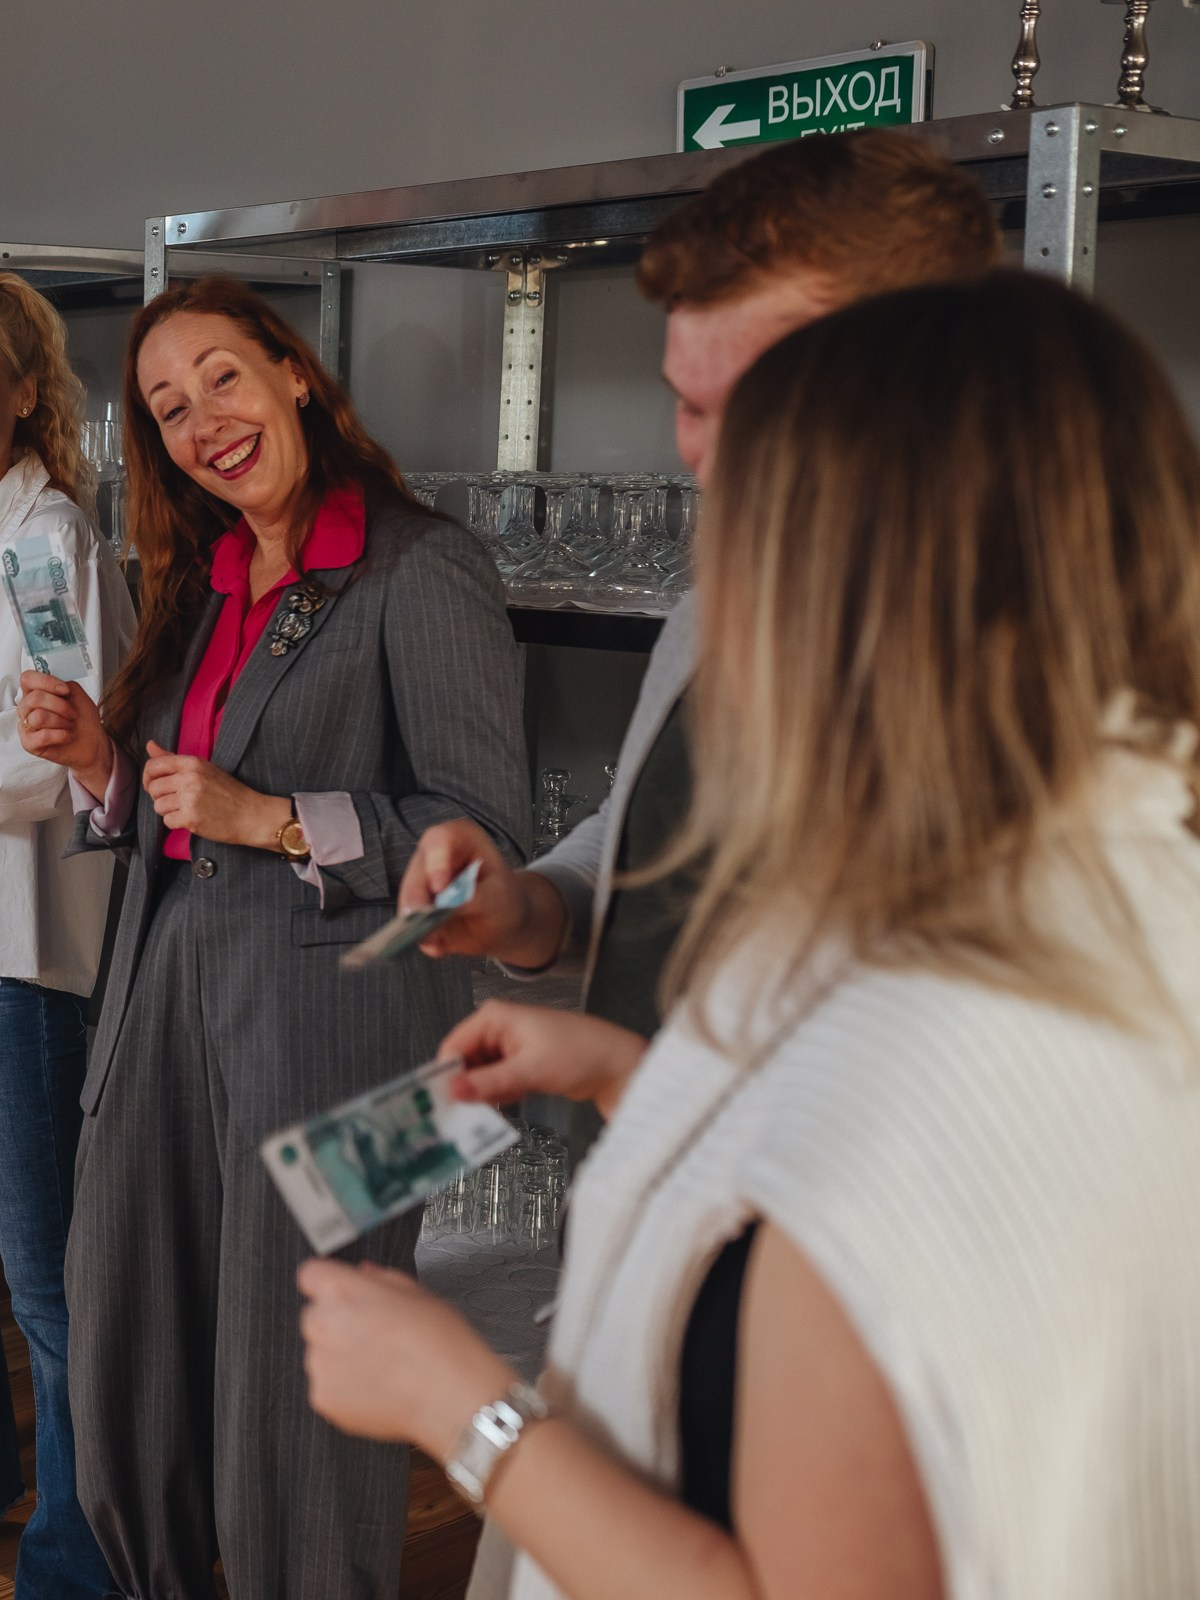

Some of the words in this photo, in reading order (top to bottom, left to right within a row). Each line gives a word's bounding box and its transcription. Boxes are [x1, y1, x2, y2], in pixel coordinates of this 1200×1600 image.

[768, 66, 901, 124] ВЫХОД
[3, 552, 15, 576] 1000
[47, 556, 68, 595] 1000
